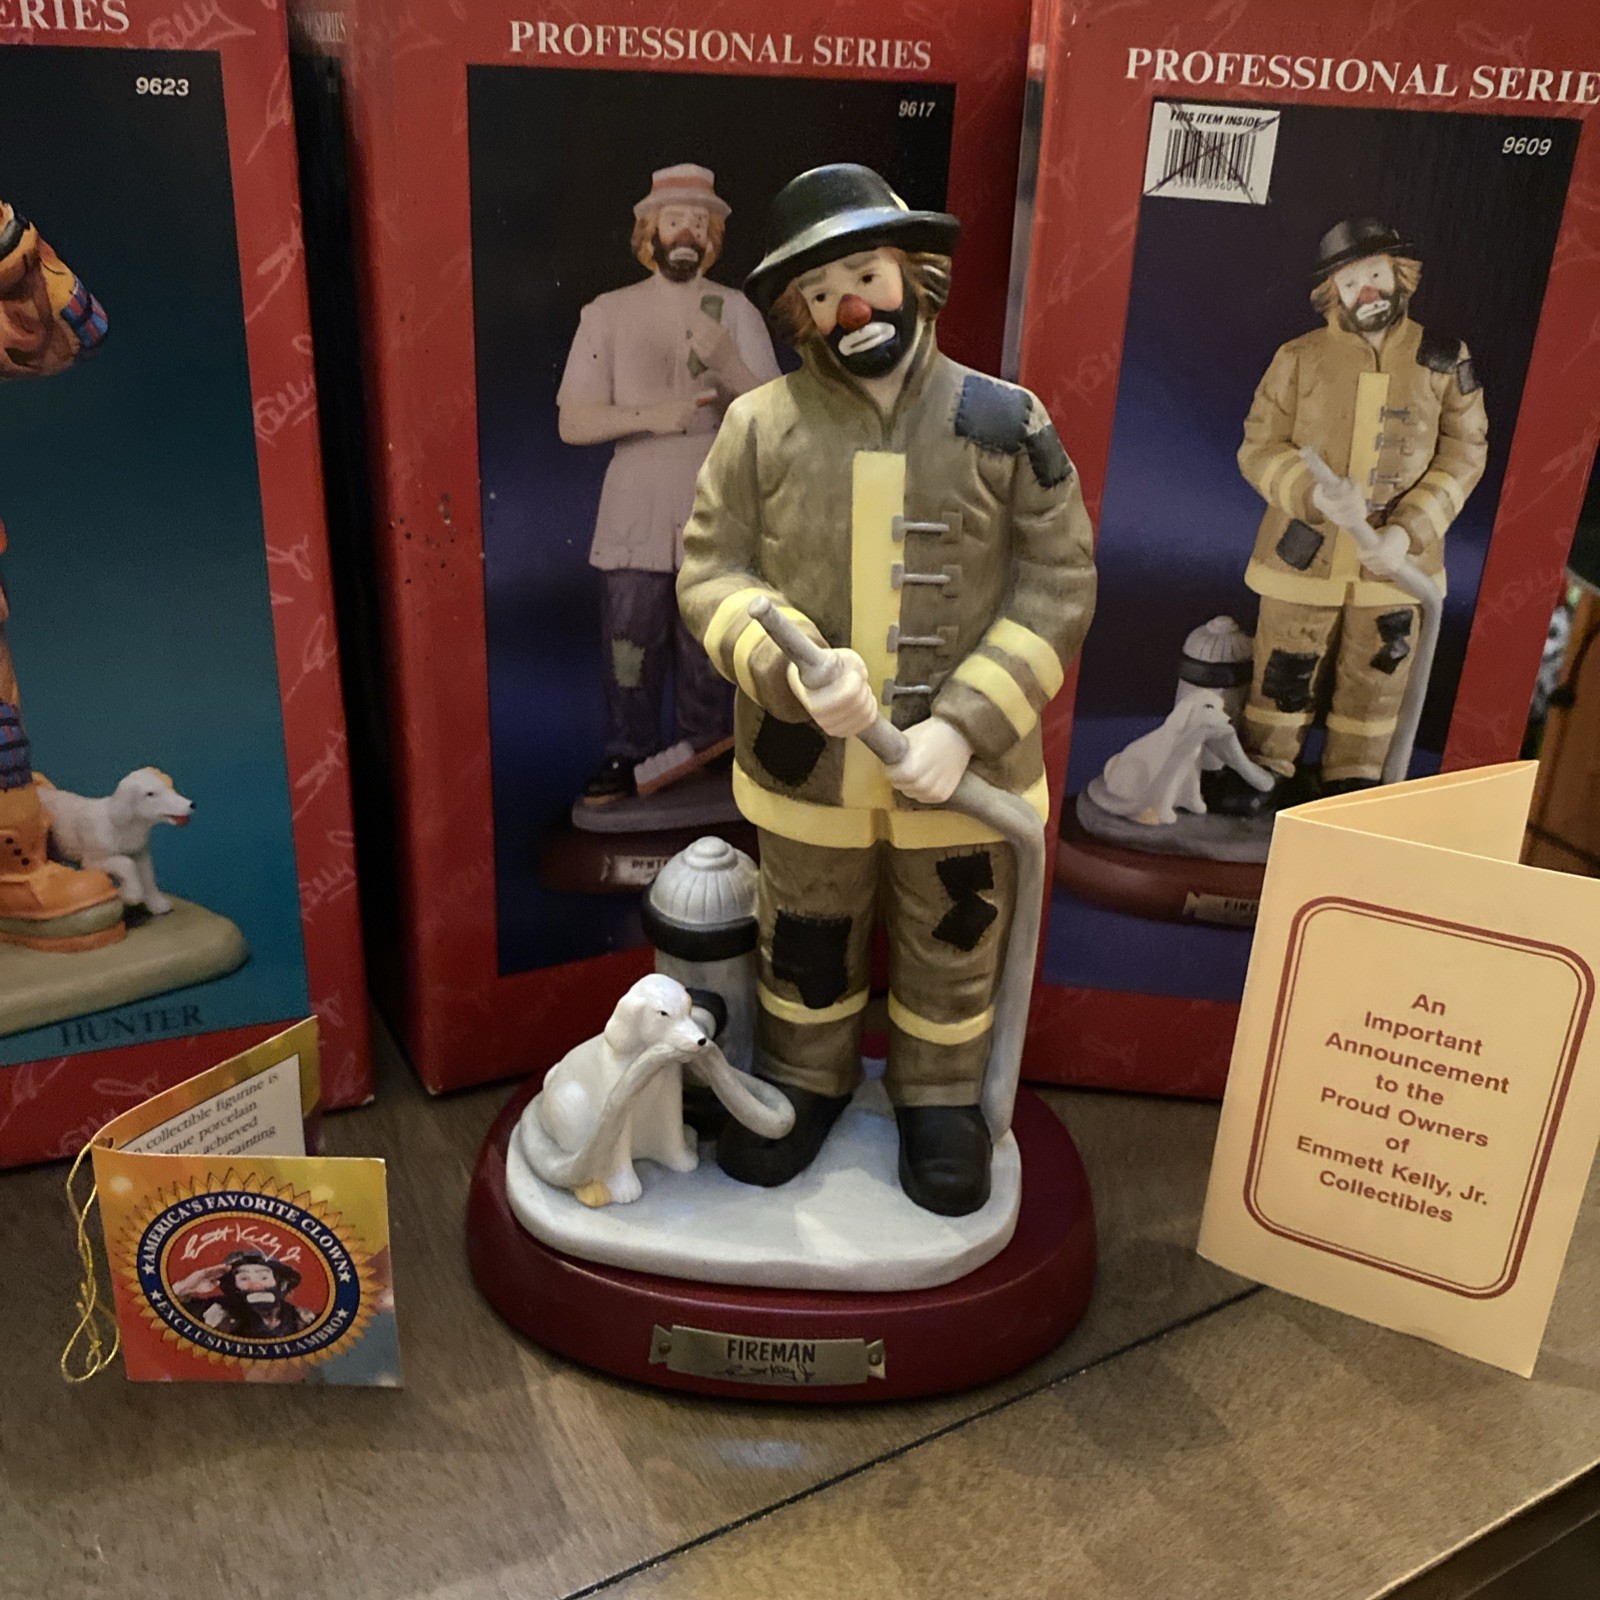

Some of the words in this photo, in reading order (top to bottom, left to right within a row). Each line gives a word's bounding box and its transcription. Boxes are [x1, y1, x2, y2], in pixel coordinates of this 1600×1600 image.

[509, 20, 803, 65] PROFESSIONAL
[812, 35, 932, 71] SERIES
[135, 76, 189, 96] 9623
[1125, 47, 1457, 98] PROFESSIONAL
[898, 100, 935, 119] 9617
[1196, 112, 1223, 125] ITEM
[1225, 114, 1262, 128] INSIDE
[1502, 136, 1552, 156] 9609
[60, 1004, 203, 1048] HUNTER
[1410, 993, 1446, 1016] An
[1364, 1010, 1483, 1056] Important
[1324, 1031, 1510, 1094] Announcement
[146, 1108, 211, 1150] collectible
[215, 1081, 265, 1113] figurine
[268, 1071, 279, 1085] is
[1376, 1073, 1398, 1093] to
[1407, 1082, 1445, 1106] the
[200, 1101, 257, 1141] porcelain
[203, 1116, 258, 1155] achieved
[1320, 1086, 1390, 1120] Proud
[1398, 1109, 1488, 1148] Owners
[1385, 1136, 1410, 1153] of
[1296, 1135, 1384, 1175] Emmett
[1391, 1163, 1452, 1198] Kelly,
[1459, 1185, 1488, 1206] Jr.
[1319, 1170, 1453, 1222] Collectibles
[142, 1195, 203, 1264] AMERICA'S
[207, 1195, 298, 1222] FAVORITE
[301, 1217, 351, 1274] CLOWN
[155, 1300, 268, 1356] EXCLUSIVELY
[274, 1315, 344, 1355] FLAMBRO
[727, 1339, 816, 1364] FIREMAN
